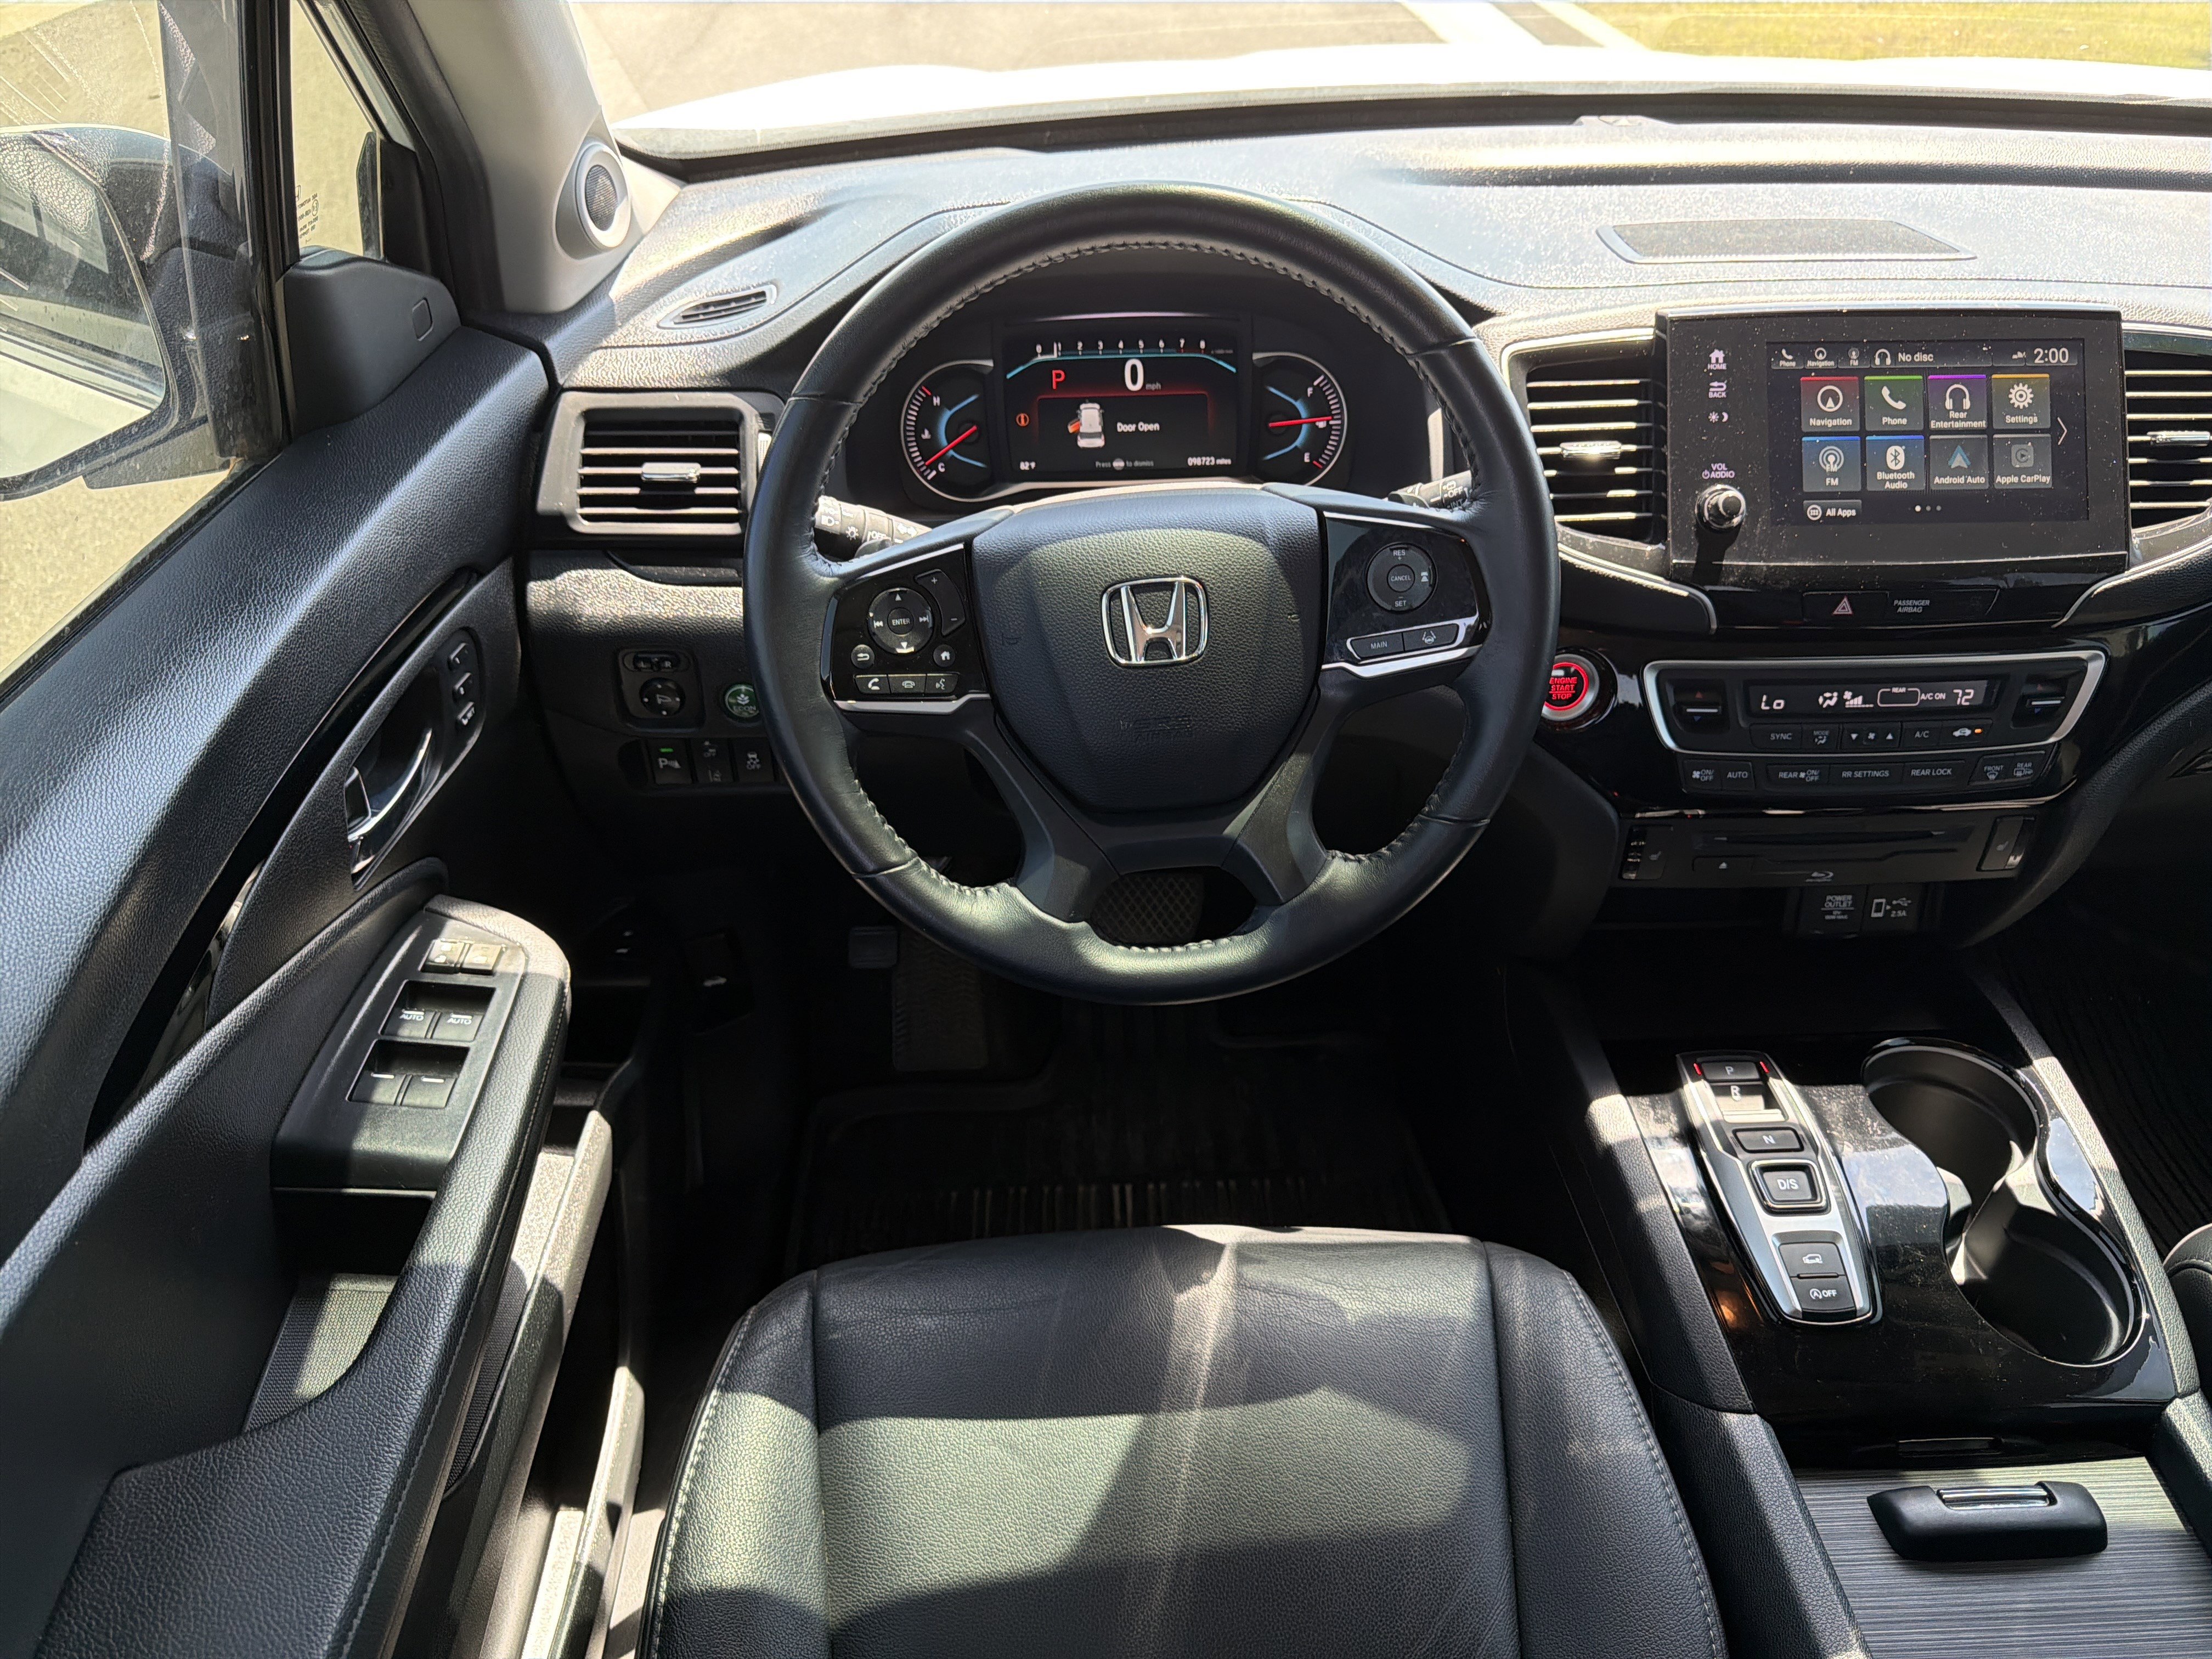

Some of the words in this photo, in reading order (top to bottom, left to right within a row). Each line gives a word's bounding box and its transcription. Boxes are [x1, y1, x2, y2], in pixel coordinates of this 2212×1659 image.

[1036, 344, 1042, 353] 0
[1077, 341, 1084, 350] 2
[1098, 341, 1104, 349] 3
[1118, 340, 1124, 349] 4
[1138, 340, 1144, 349] 5
[1159, 340, 1165, 348] 6
[1180, 338, 1185, 348] 7
[1200, 340, 1205, 348] 8
[1898, 352, 1911, 362] No
[1914, 352, 1934, 362] disc
[2034, 348, 2069, 364] 2:00
[1052, 369, 1065, 390] P
[1124, 358, 1144, 391] 0
[1146, 382, 1161, 391] mph
[1307, 387, 1313, 397] F
[933, 396, 940, 406] H
[1949, 411, 1967, 419] Rear
[2005, 415, 2038, 425] Settings
[1809, 417, 1852, 427] Navigation
[1882, 417, 1908, 425] Phone
[1931, 420, 1986, 429] Entertainment
[1117, 422, 1136, 432] Door
[1138, 421, 1160, 432] Open
[1187, 456, 1215, 466] 098723
[1304, 452, 1310, 462] E
[938, 462, 945, 472] C
[1711, 470, 1735, 479] AUDIO
[1877, 471, 1915, 480] Bluetooth
[1934, 476, 1965, 484] Android
[1967, 475, 1985, 484] Auto
[1995, 475, 2018, 485] Apple
[2021, 474, 2051, 485] CarPlay
[1826, 477, 1838, 486] FM
[1884, 481, 1908, 489] Audio
[1448, 486, 1464, 498] OFF
[1826, 508, 1836, 517] All
[1837, 508, 1856, 518] Apps
[1953, 689, 1974, 706] 72
[1915, 730, 1929, 738] A/C
[399, 1013, 424, 1022] AUTO
[447, 1017, 472, 1025] AUTO
[1725, 1066, 1734, 1075] P
[1730, 1085, 1742, 1101] R
[1762, 1135, 1776, 1144] N
[1776, 1178, 1799, 1190] D/S
[1821, 1289, 1837, 1298] OFF
